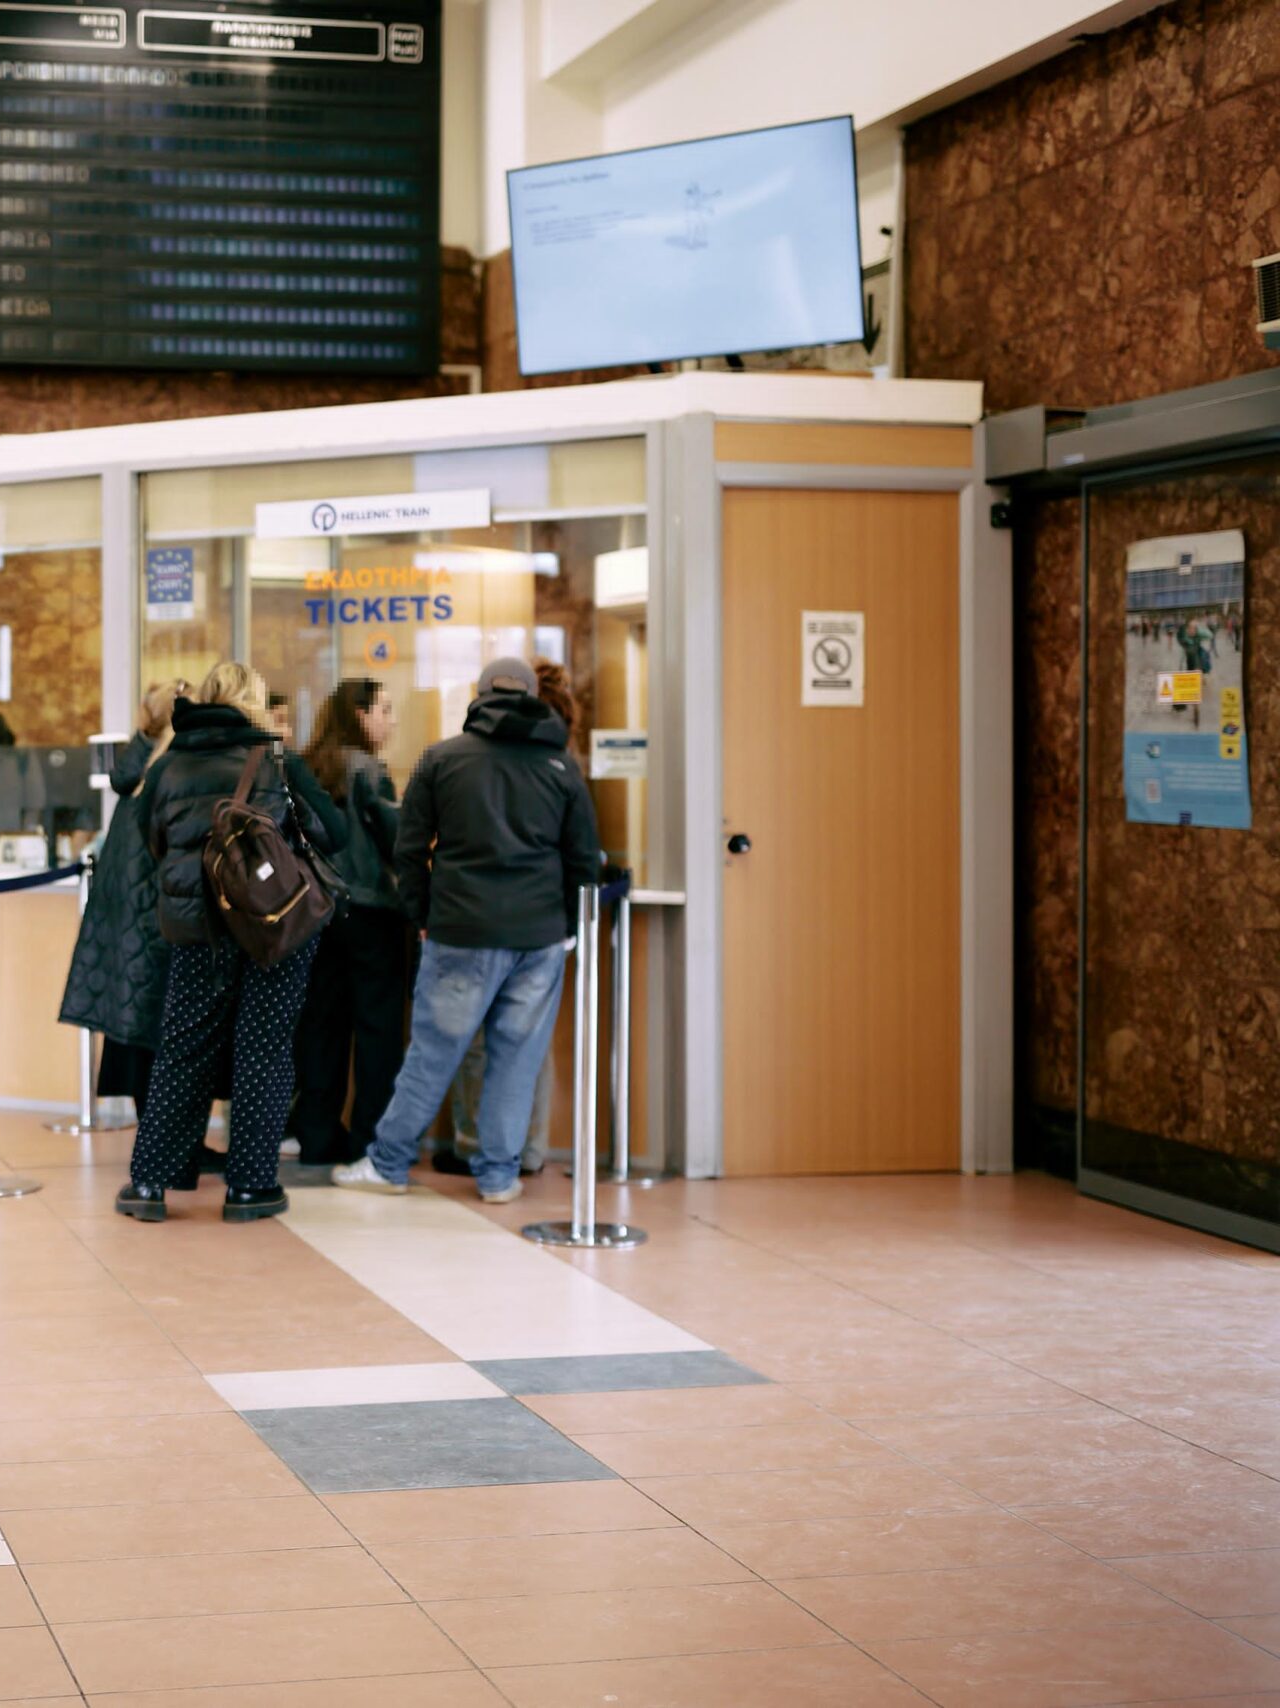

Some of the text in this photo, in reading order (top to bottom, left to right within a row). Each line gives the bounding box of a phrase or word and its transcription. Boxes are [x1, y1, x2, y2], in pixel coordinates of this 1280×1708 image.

[341, 506, 431, 522] HELLENIC TRAIN
[304, 594, 454, 625] TICKETS
[374, 643, 388, 659] 4
